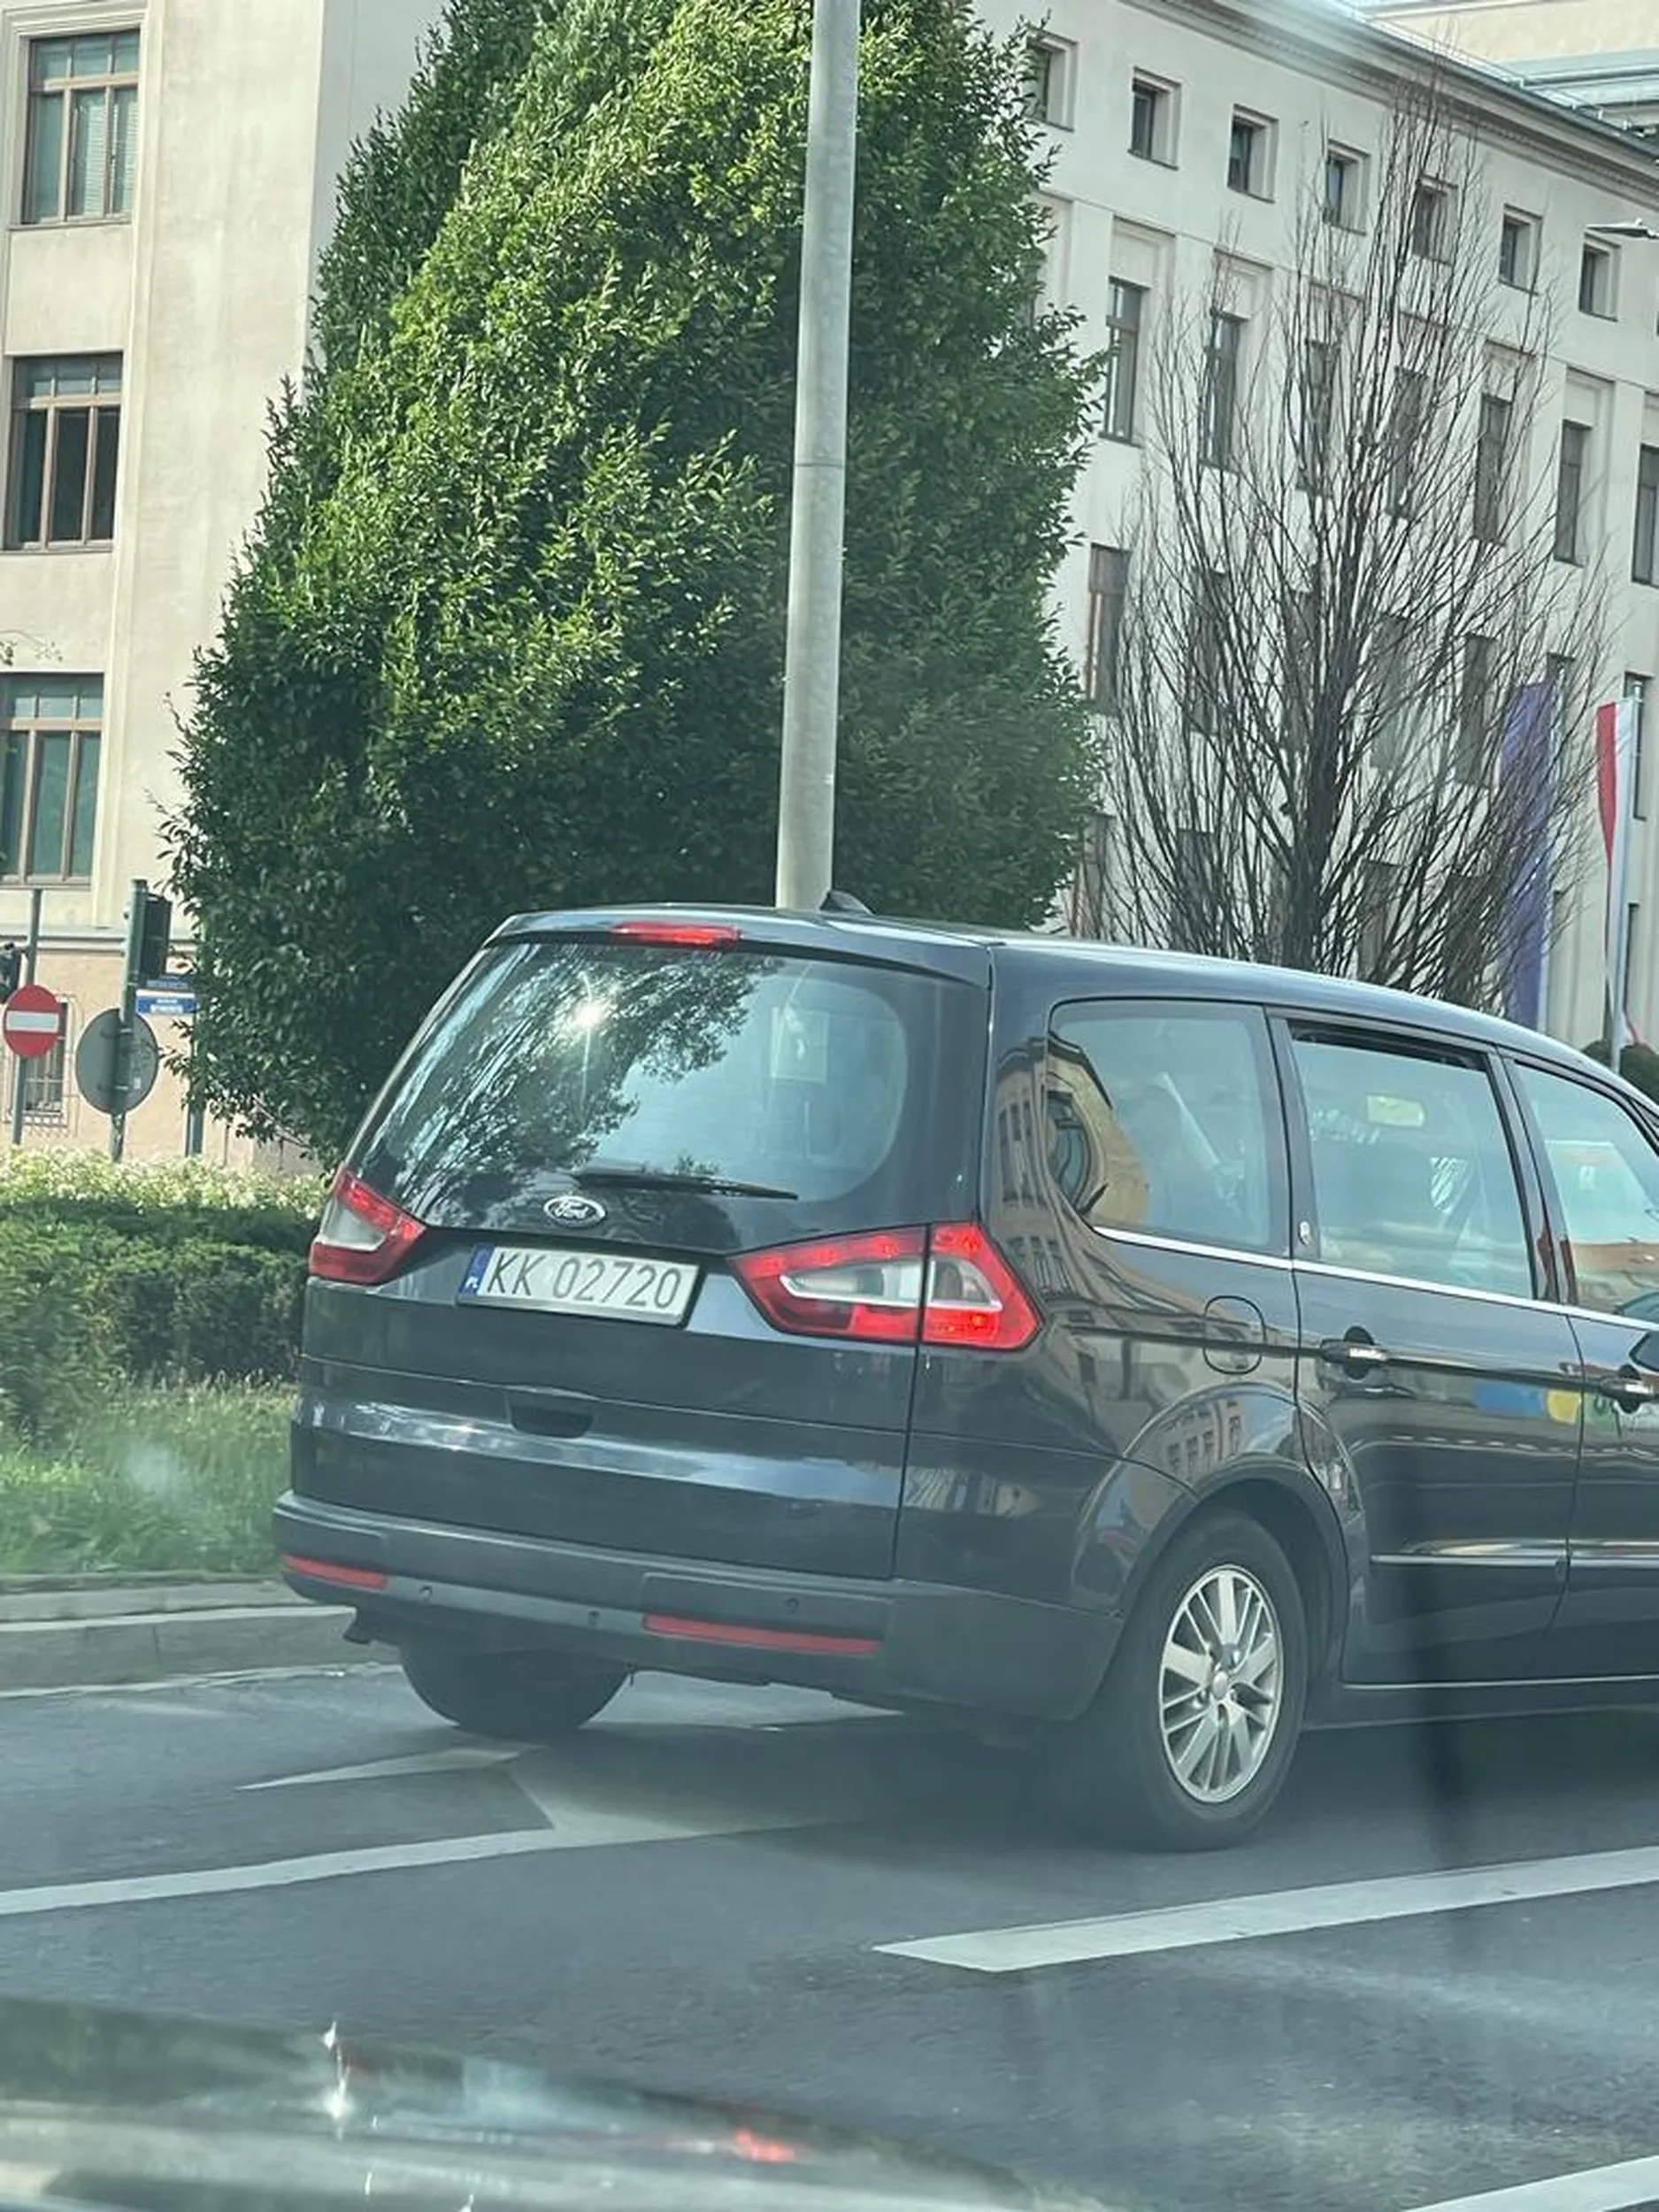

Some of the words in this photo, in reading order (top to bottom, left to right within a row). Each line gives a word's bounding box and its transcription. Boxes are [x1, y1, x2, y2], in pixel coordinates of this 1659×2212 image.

[554, 1199, 589, 1218] Ford
[487, 1252, 545, 1296] KK
[553, 1258, 680, 1309] 02720
